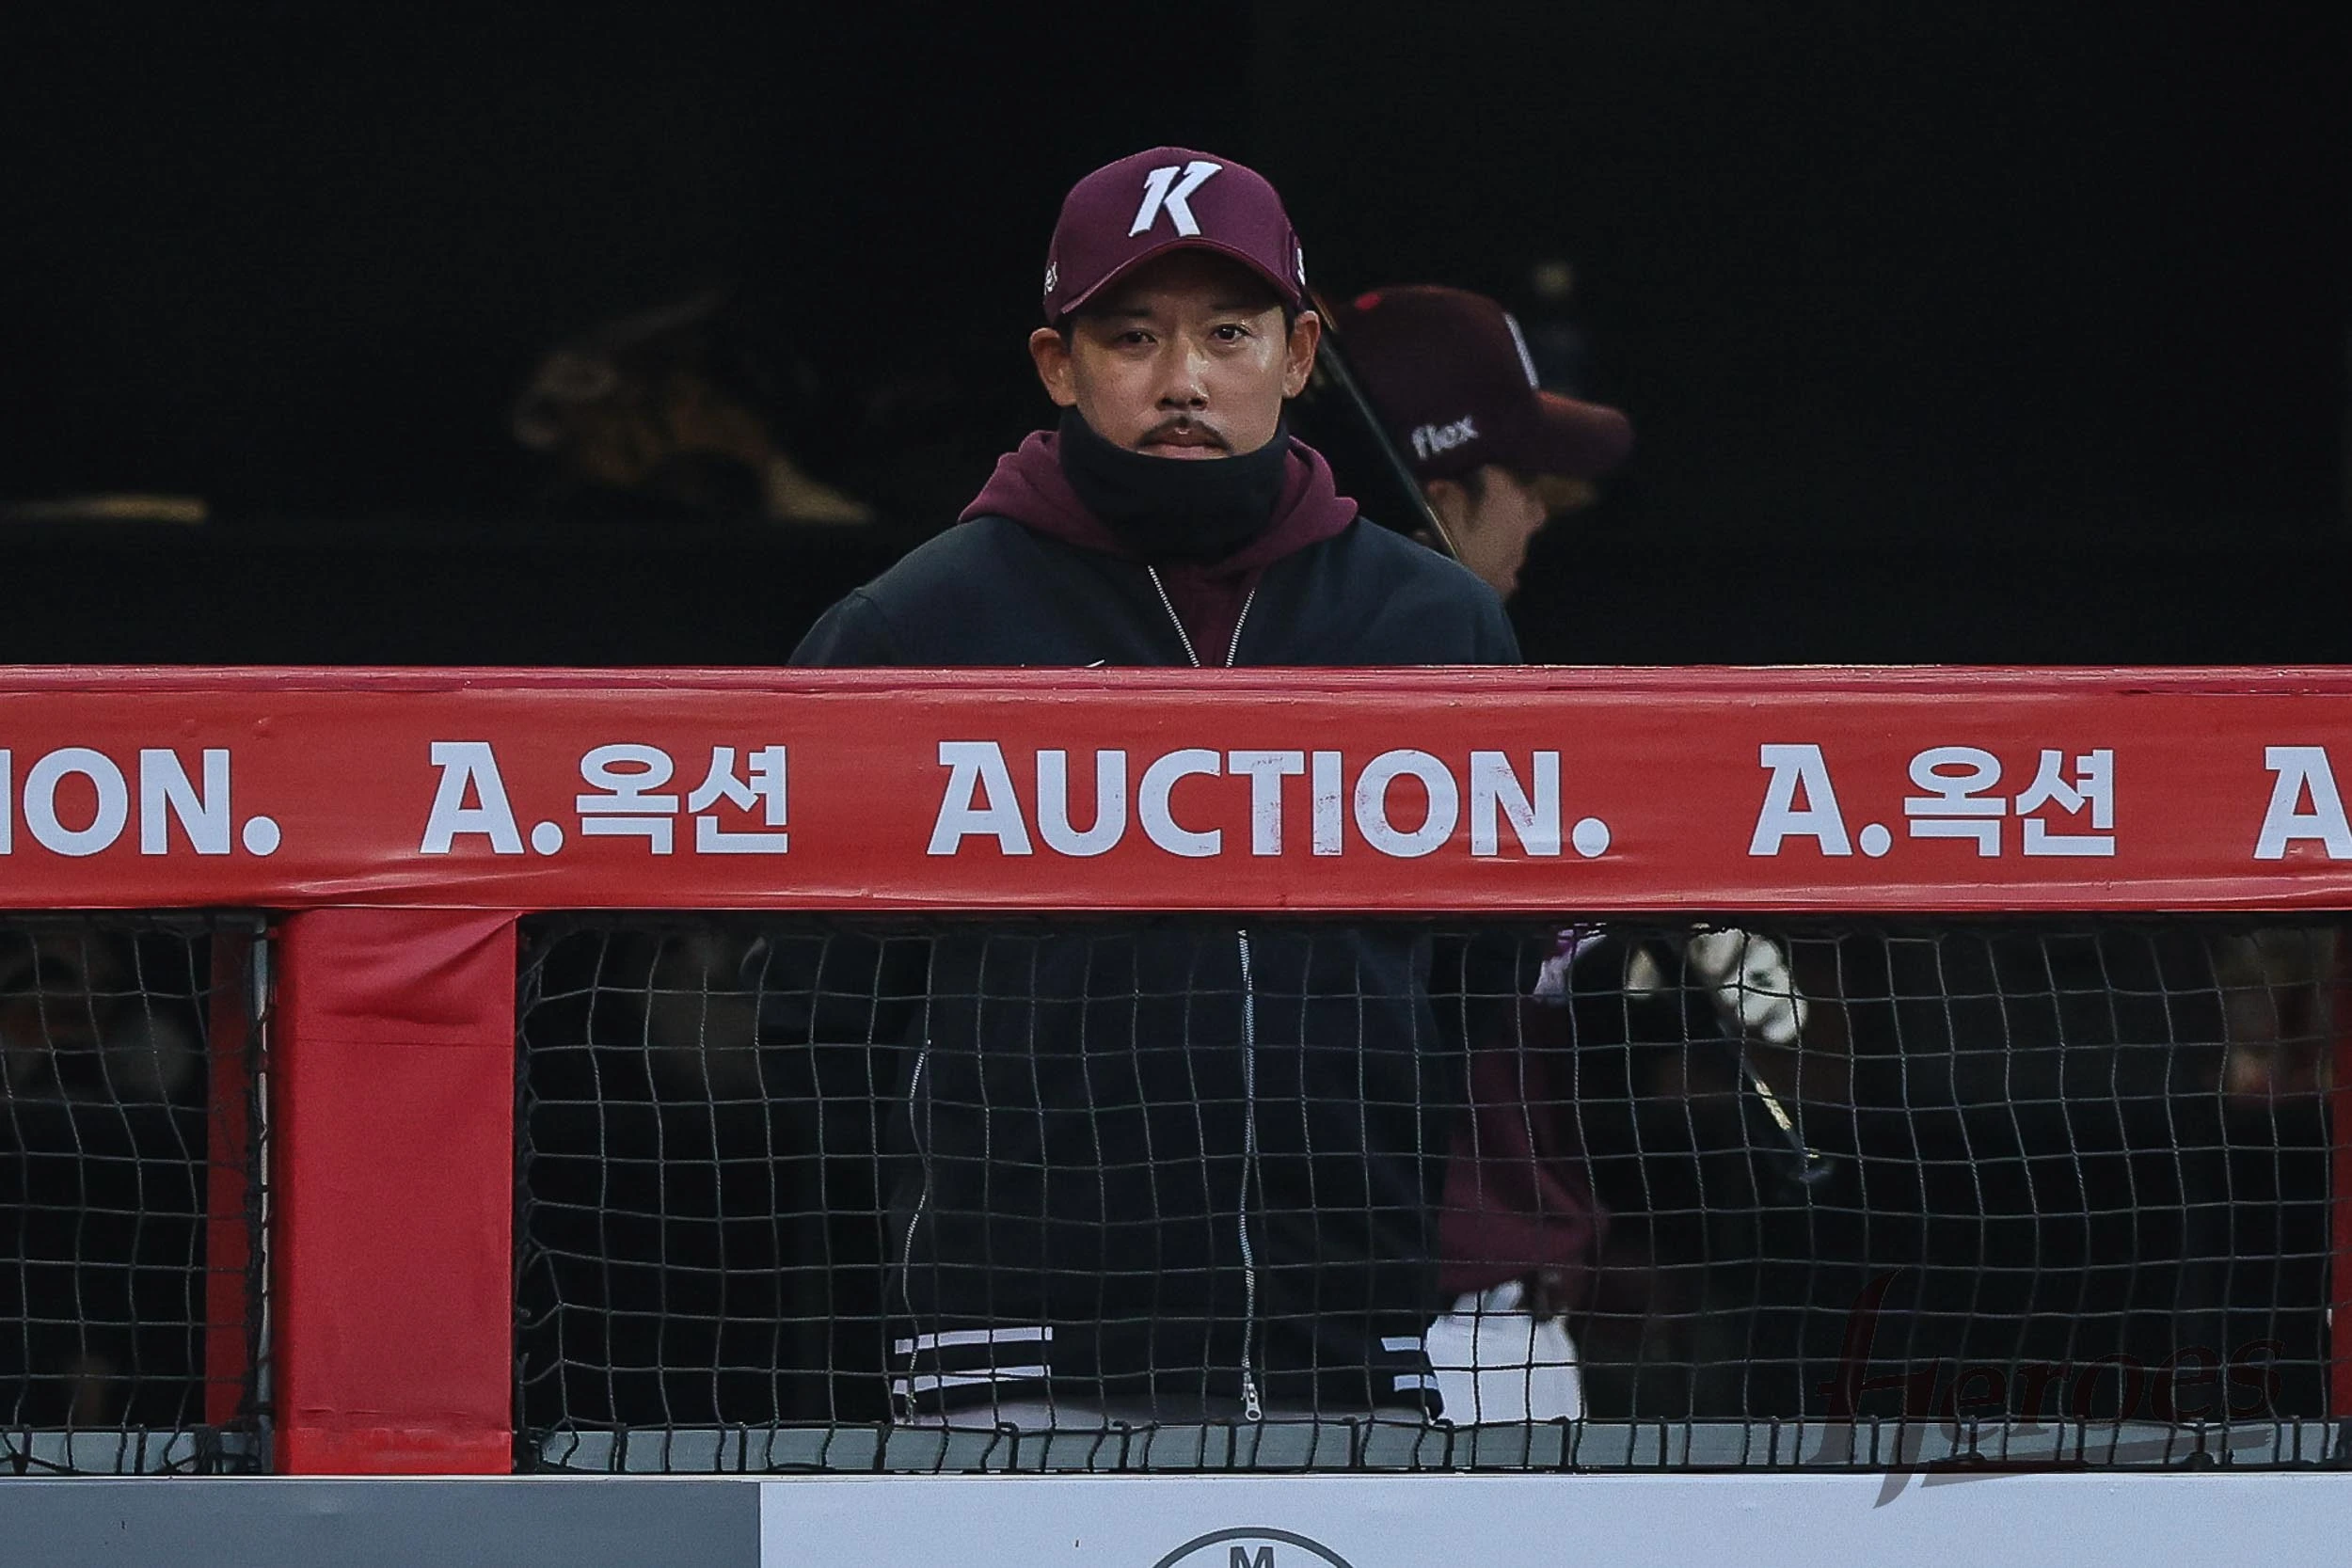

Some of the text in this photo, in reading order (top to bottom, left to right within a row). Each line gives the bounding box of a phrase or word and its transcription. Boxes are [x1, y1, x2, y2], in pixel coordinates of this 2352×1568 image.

[1128, 161, 1223, 237] K
[1411, 415, 1479, 461] flex
[927, 741, 1612, 858] AUCTION.
